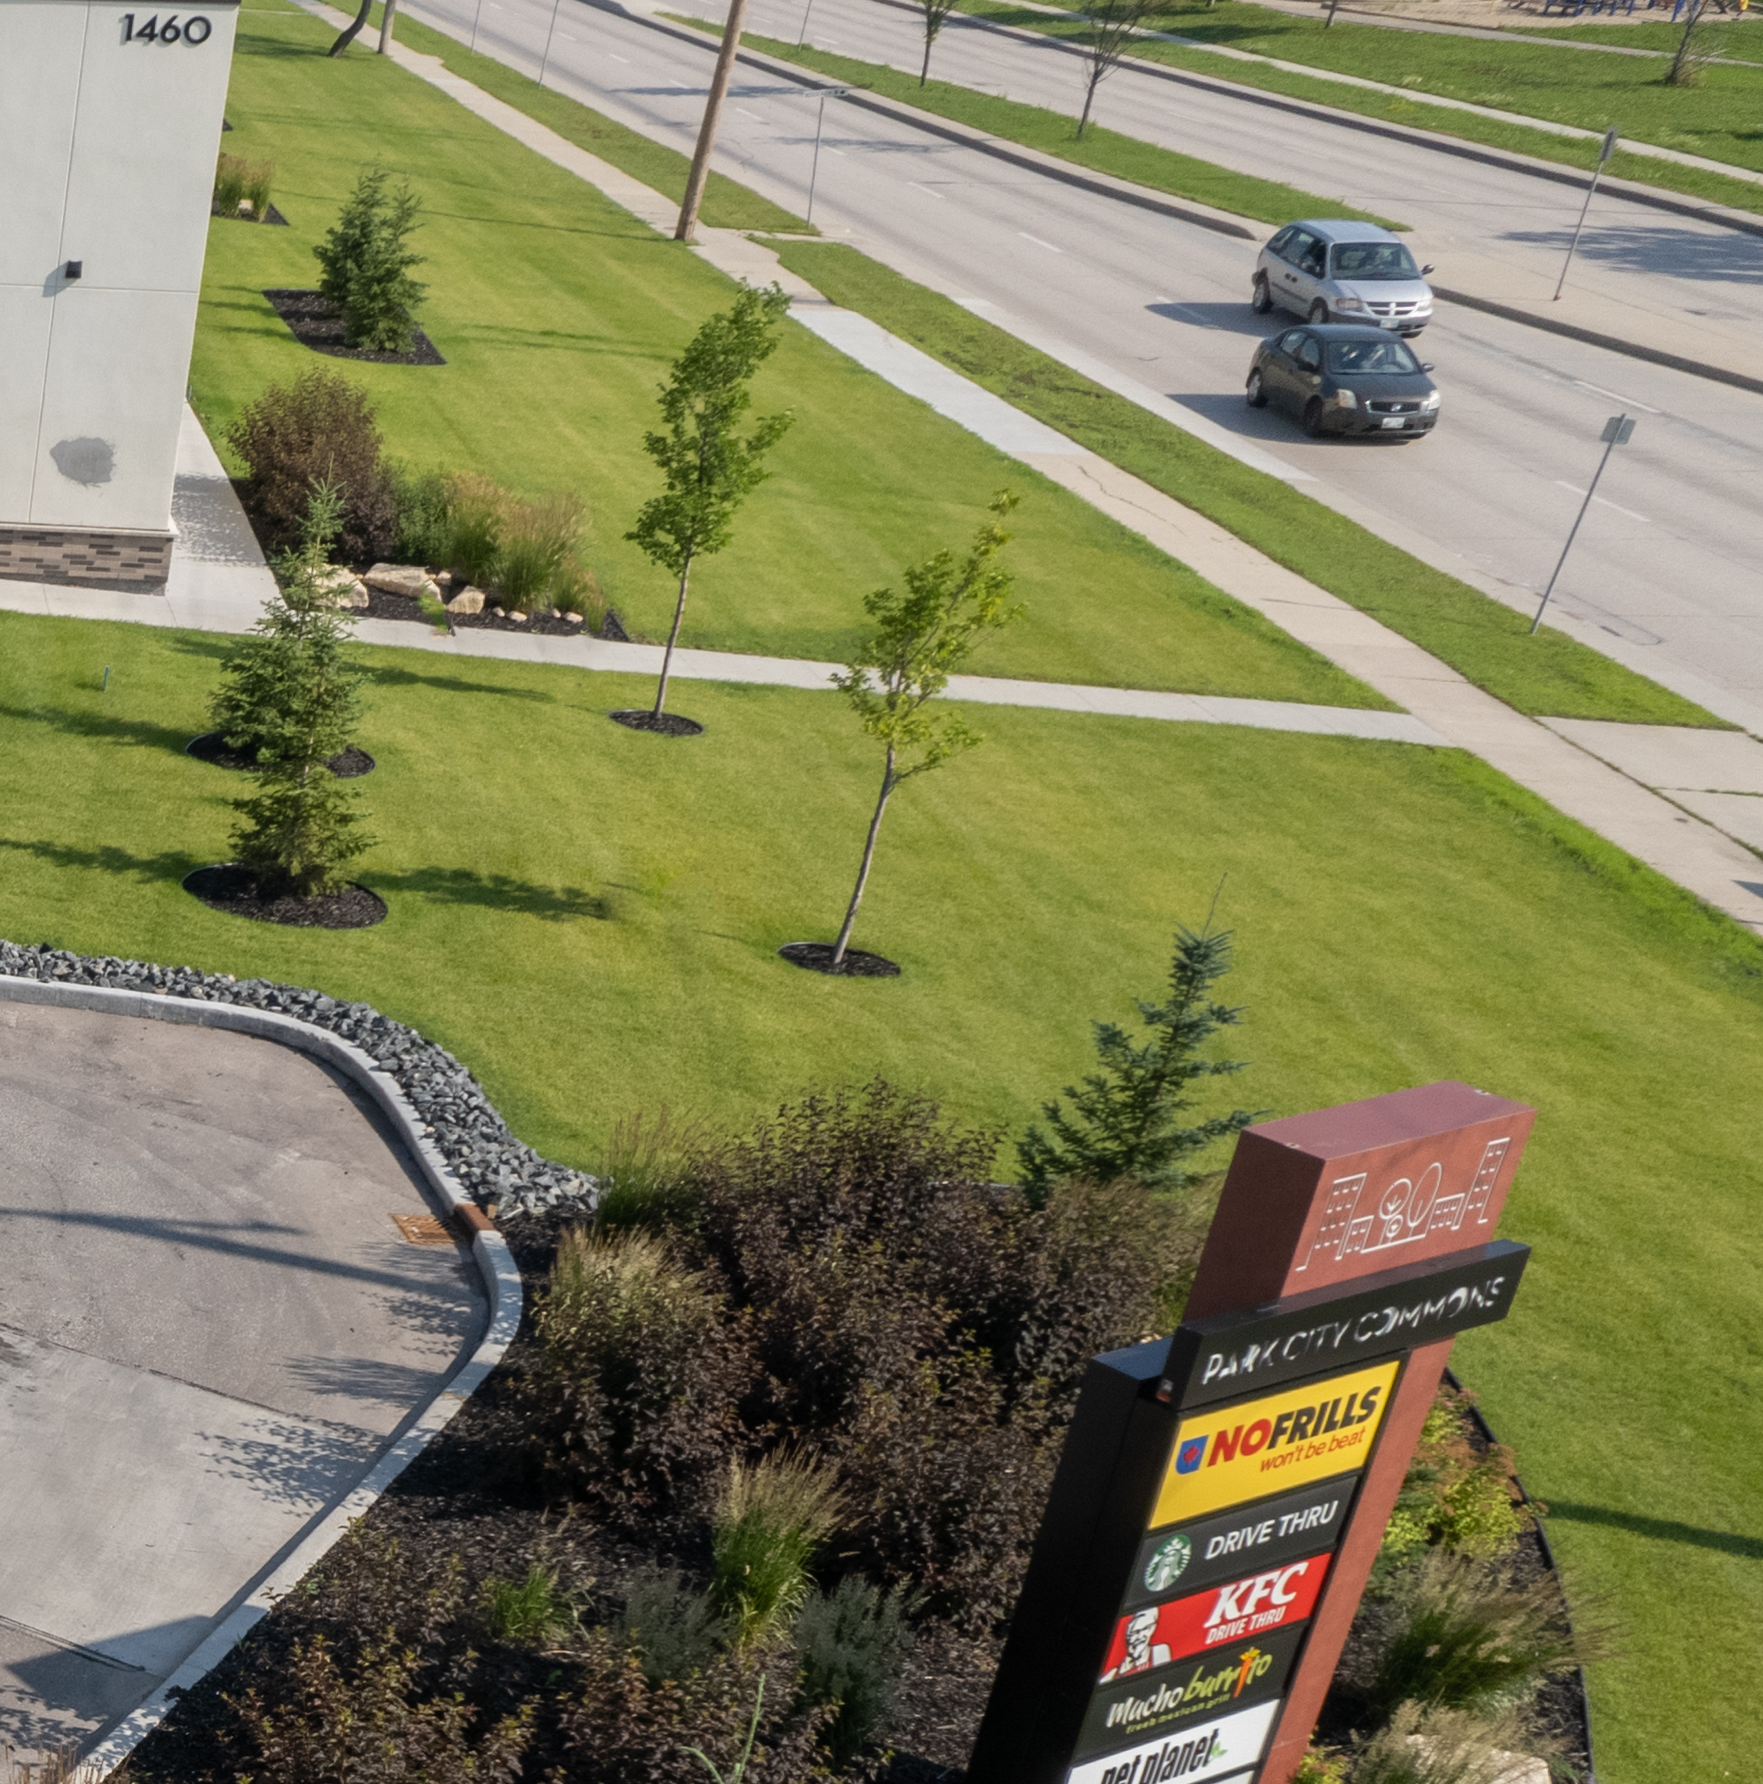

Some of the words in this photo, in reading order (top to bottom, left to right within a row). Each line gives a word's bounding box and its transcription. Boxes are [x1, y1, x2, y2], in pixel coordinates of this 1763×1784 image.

[124, 13, 212, 44] 1460
[1201, 1337, 1280, 1385] PARK
[1283, 1318, 1351, 1361] CITY
[1353, 1276, 1507, 1342] COMMONS
[1259, 1445, 1307, 1473] won't
[1305, 1442, 1329, 1462] be
[1328, 1426, 1367, 1452] beat
[1204, 1519, 1276, 1560] DRIVE
[1278, 1500, 1339, 1537] THRU
[1203, 1561, 1309, 1628] KFC
[1205, 1618, 1246, 1645] DRIVE
[1247, 1606, 1287, 1632] THRU
